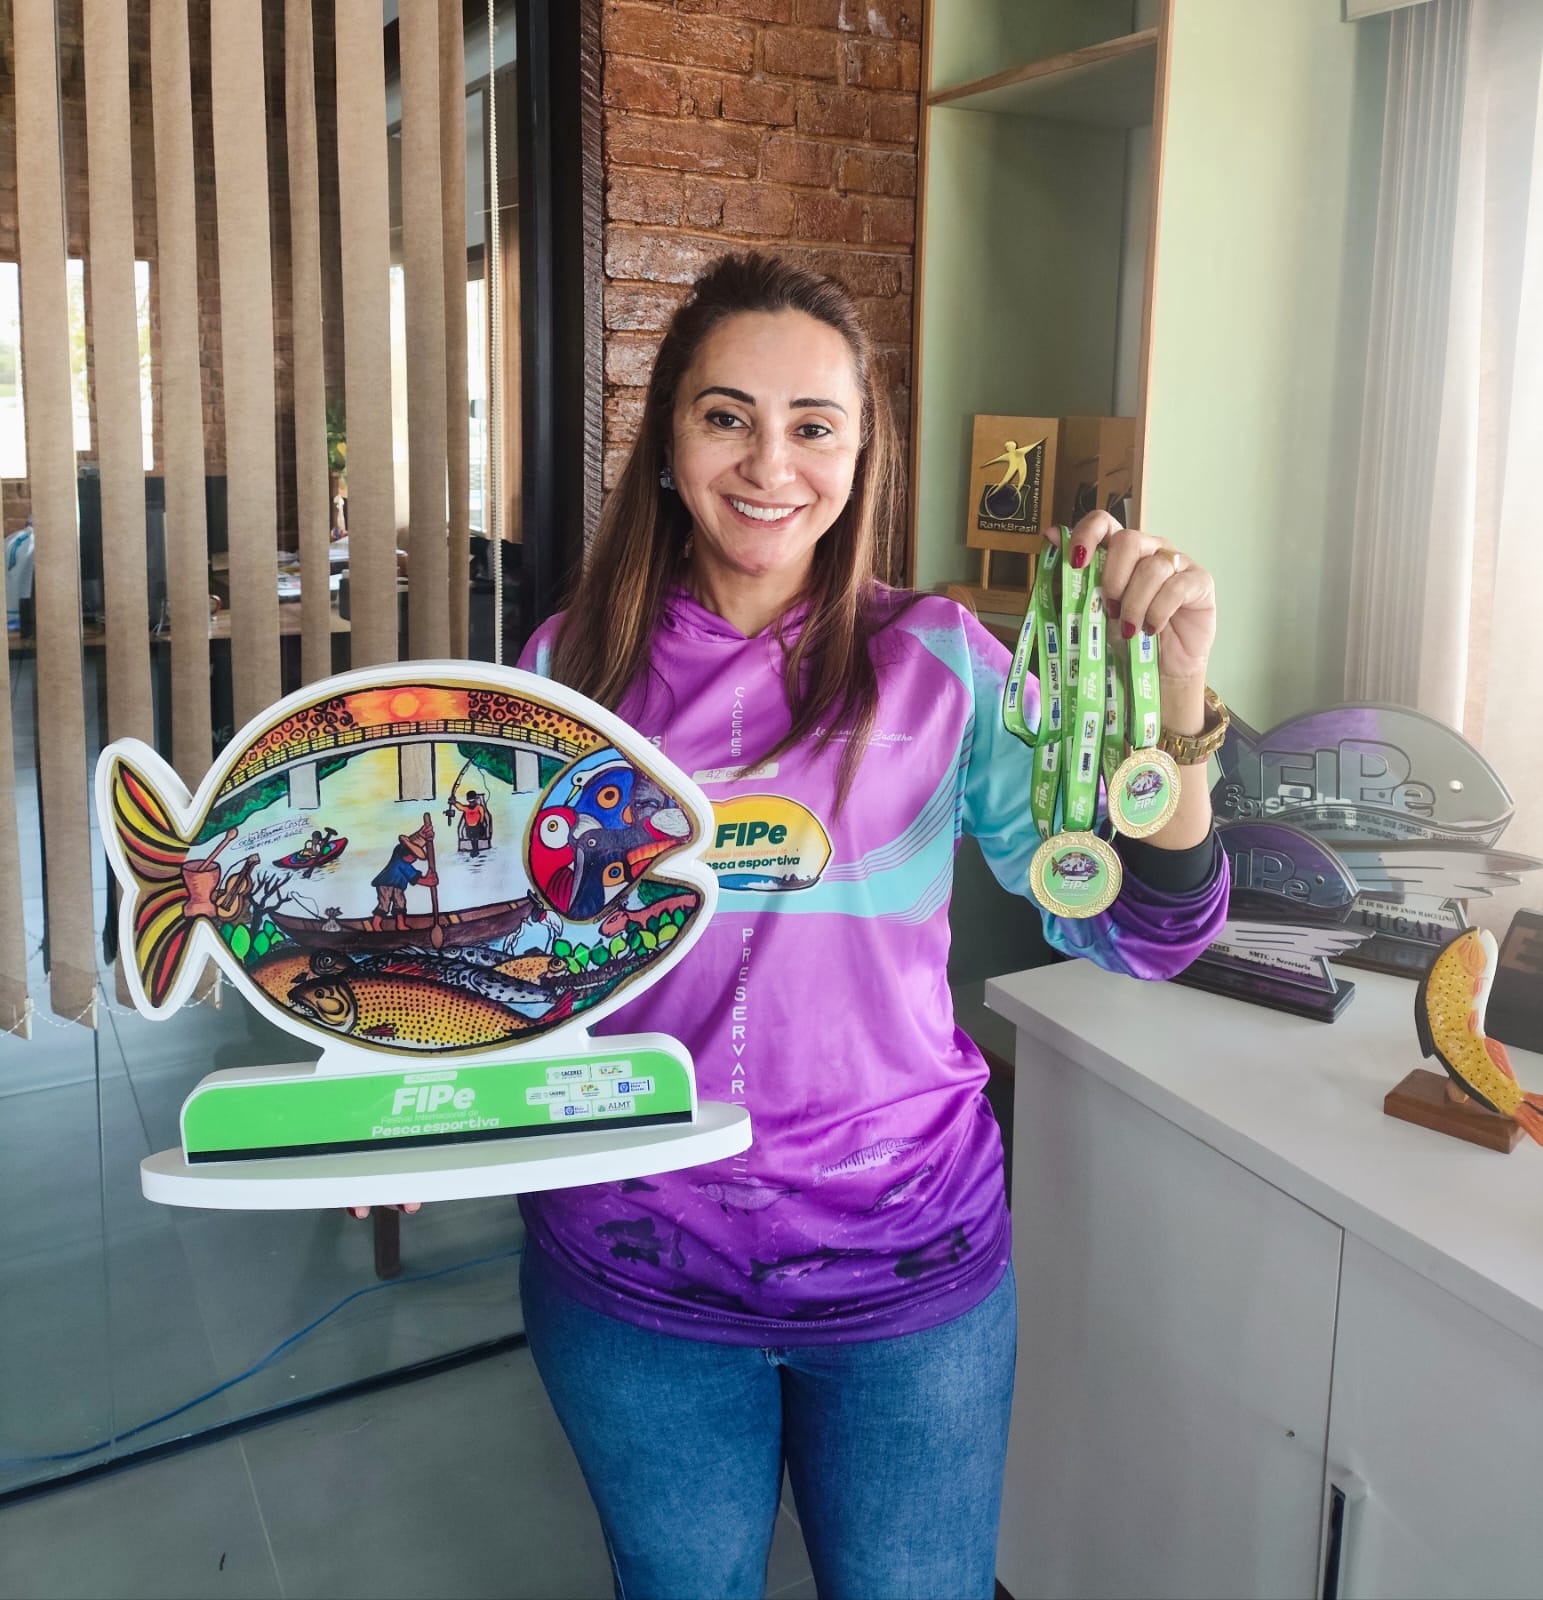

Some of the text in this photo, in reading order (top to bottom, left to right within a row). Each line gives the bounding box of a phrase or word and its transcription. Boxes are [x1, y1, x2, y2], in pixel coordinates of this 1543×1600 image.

[979, 520, 1037, 534] RankBrasil
[1072, 571, 1082, 600] FIPe
[1087, 671, 1097, 701] FIPe
[1142, 671, 1153, 700] FIPe
[731, 686, 745, 757] CACERES
[1259, 738, 1436, 818] FIPe
[1038, 782, 1050, 809] FIPe
[1074, 796, 1087, 822] FIPe
[715, 821, 788, 849] FIPe
[705, 855, 800, 870] esca esportiva
[1228, 847, 1311, 901] IPe
[1061, 880, 1090, 891] FIPe
[1361, 909, 1442, 941] LUGAR
[731, 928, 754, 1095] PRESERVAR
[392, 1084, 476, 1115] FIPe
[608, 1101, 631, 1110] ALMT
[371, 1116, 500, 1138] Pesca esportiva
